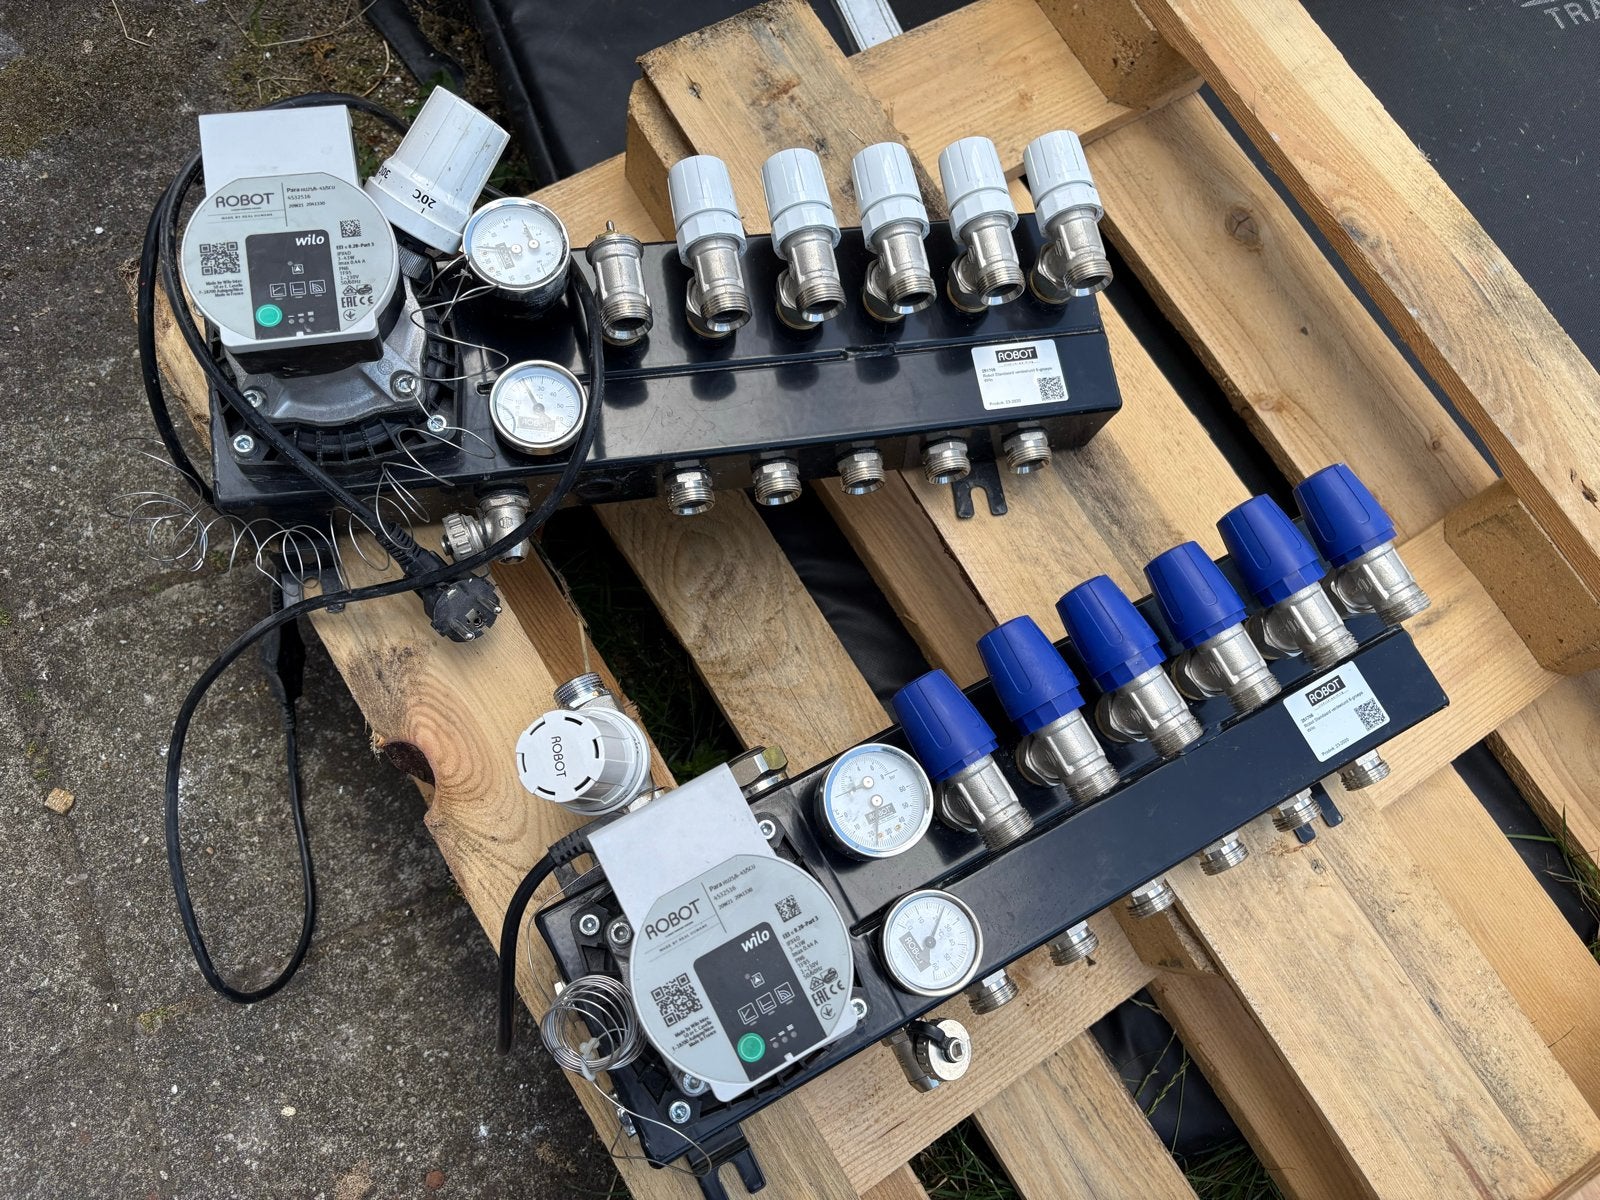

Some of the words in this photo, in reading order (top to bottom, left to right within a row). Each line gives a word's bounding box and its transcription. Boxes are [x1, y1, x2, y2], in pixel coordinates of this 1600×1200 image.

[216, 193, 274, 208] ROBOT
[296, 234, 324, 246] wilo
[998, 349, 1034, 361] ROBOT
[1309, 679, 1340, 703] ROBOT
[551, 736, 566, 777] ROBOT
[709, 882, 722, 891] Para
[645, 898, 700, 940] ROBOT
[741, 929, 770, 952] wilo
